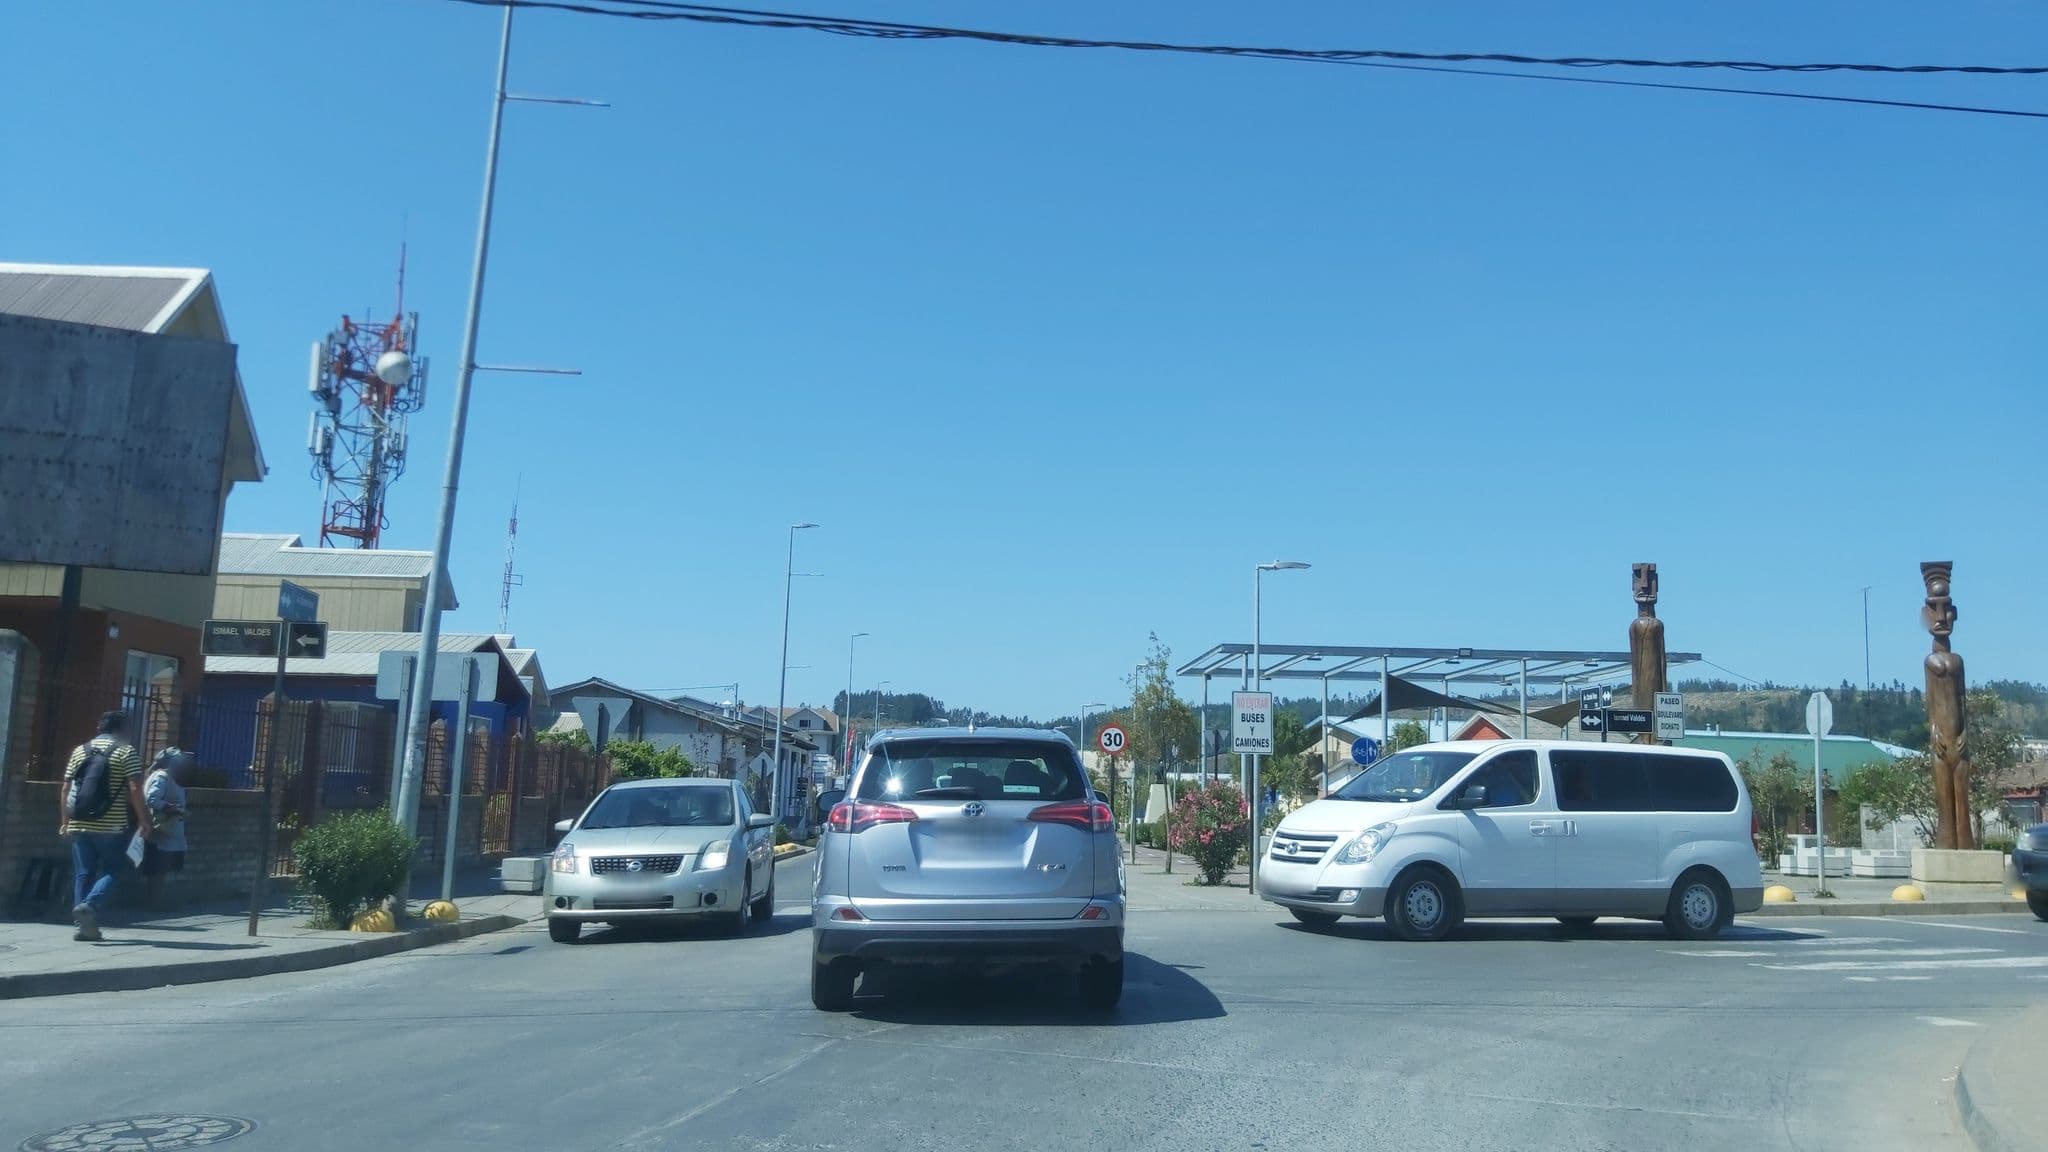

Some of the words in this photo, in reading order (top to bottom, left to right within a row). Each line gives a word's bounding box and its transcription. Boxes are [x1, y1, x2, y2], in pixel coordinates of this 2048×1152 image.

[1660, 697, 1680, 705] PASEO
[1241, 713, 1264, 722] BUSES
[1250, 726, 1254, 735] Y
[1103, 732, 1123, 747] 30
[1235, 738, 1269, 747] CAMIONES
[882, 865, 907, 873] TOYOTA
